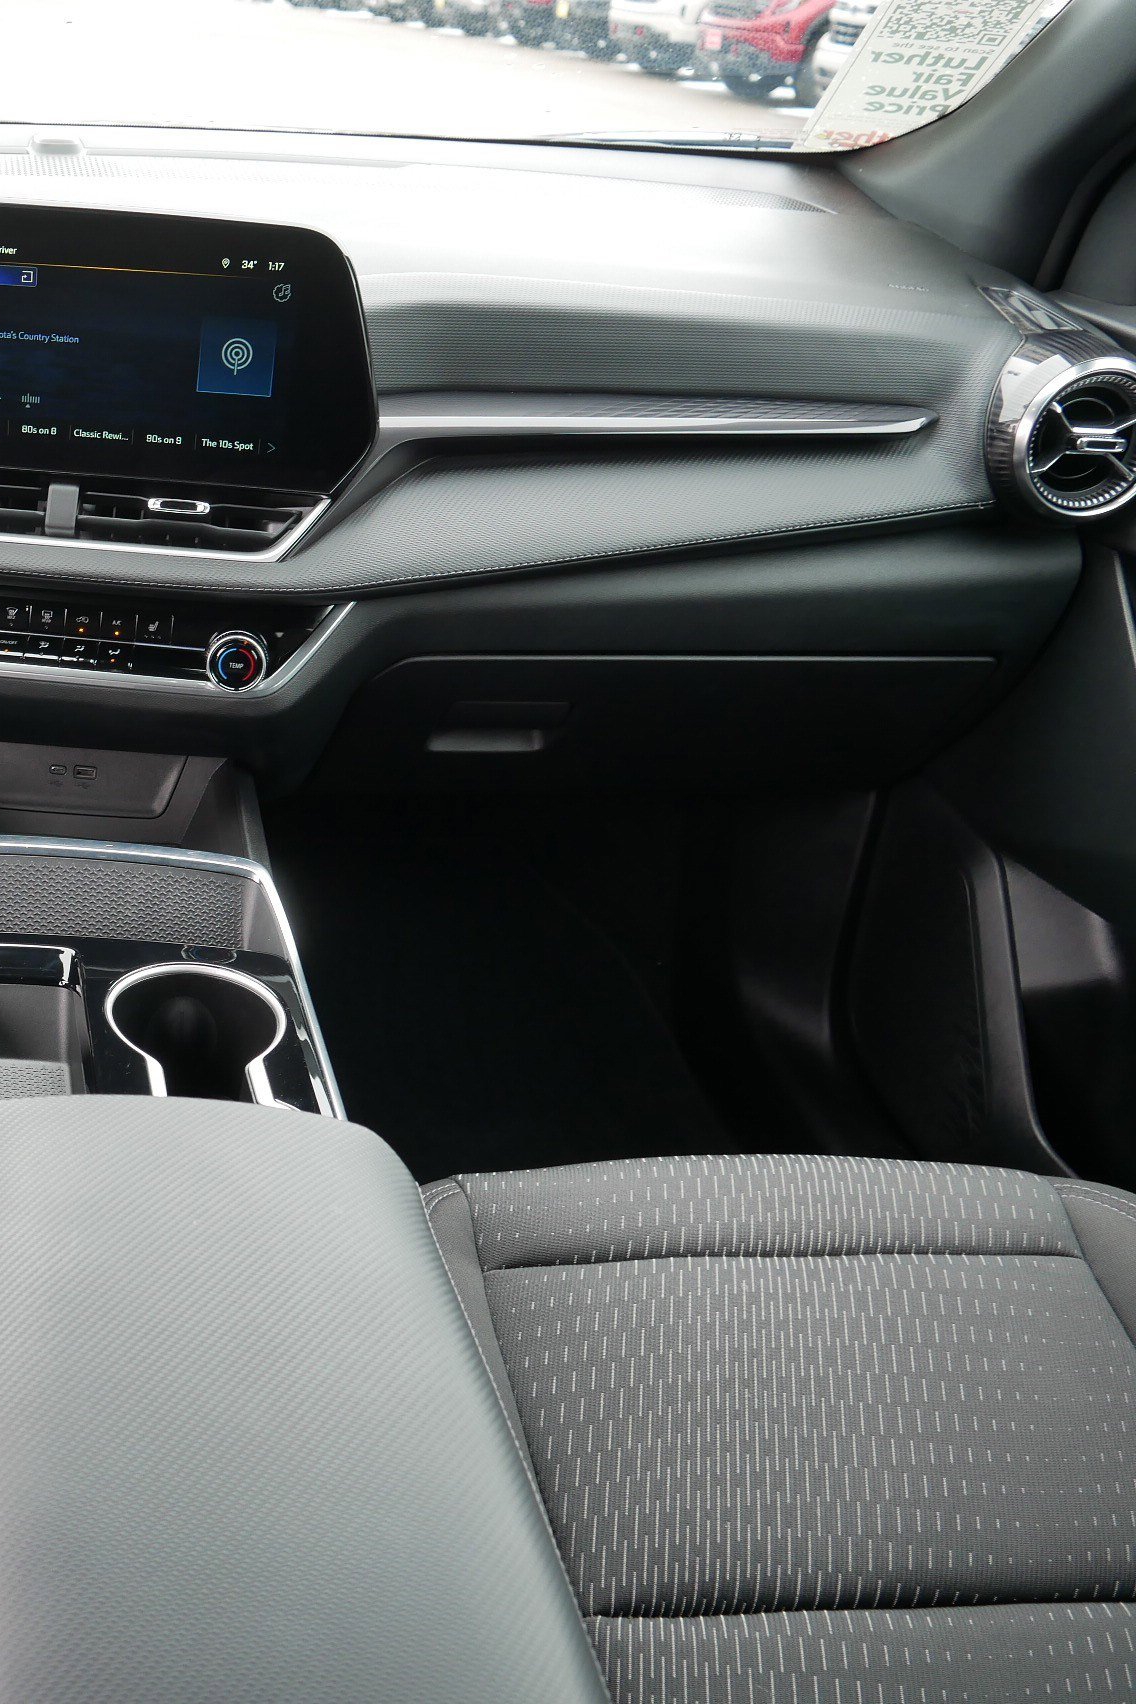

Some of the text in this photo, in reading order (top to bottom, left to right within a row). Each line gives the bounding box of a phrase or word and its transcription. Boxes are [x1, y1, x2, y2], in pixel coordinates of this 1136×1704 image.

[268, 261, 285, 271] 1:17
[18, 331, 50, 344] Country
[51, 334, 80, 344] Station
[21, 424, 57, 435] 80s on 8
[73, 428, 101, 439] Classic
[146, 434, 162, 443] 90s
[175, 436, 182, 445] 9
[201, 438, 254, 451] The 10s Spot
